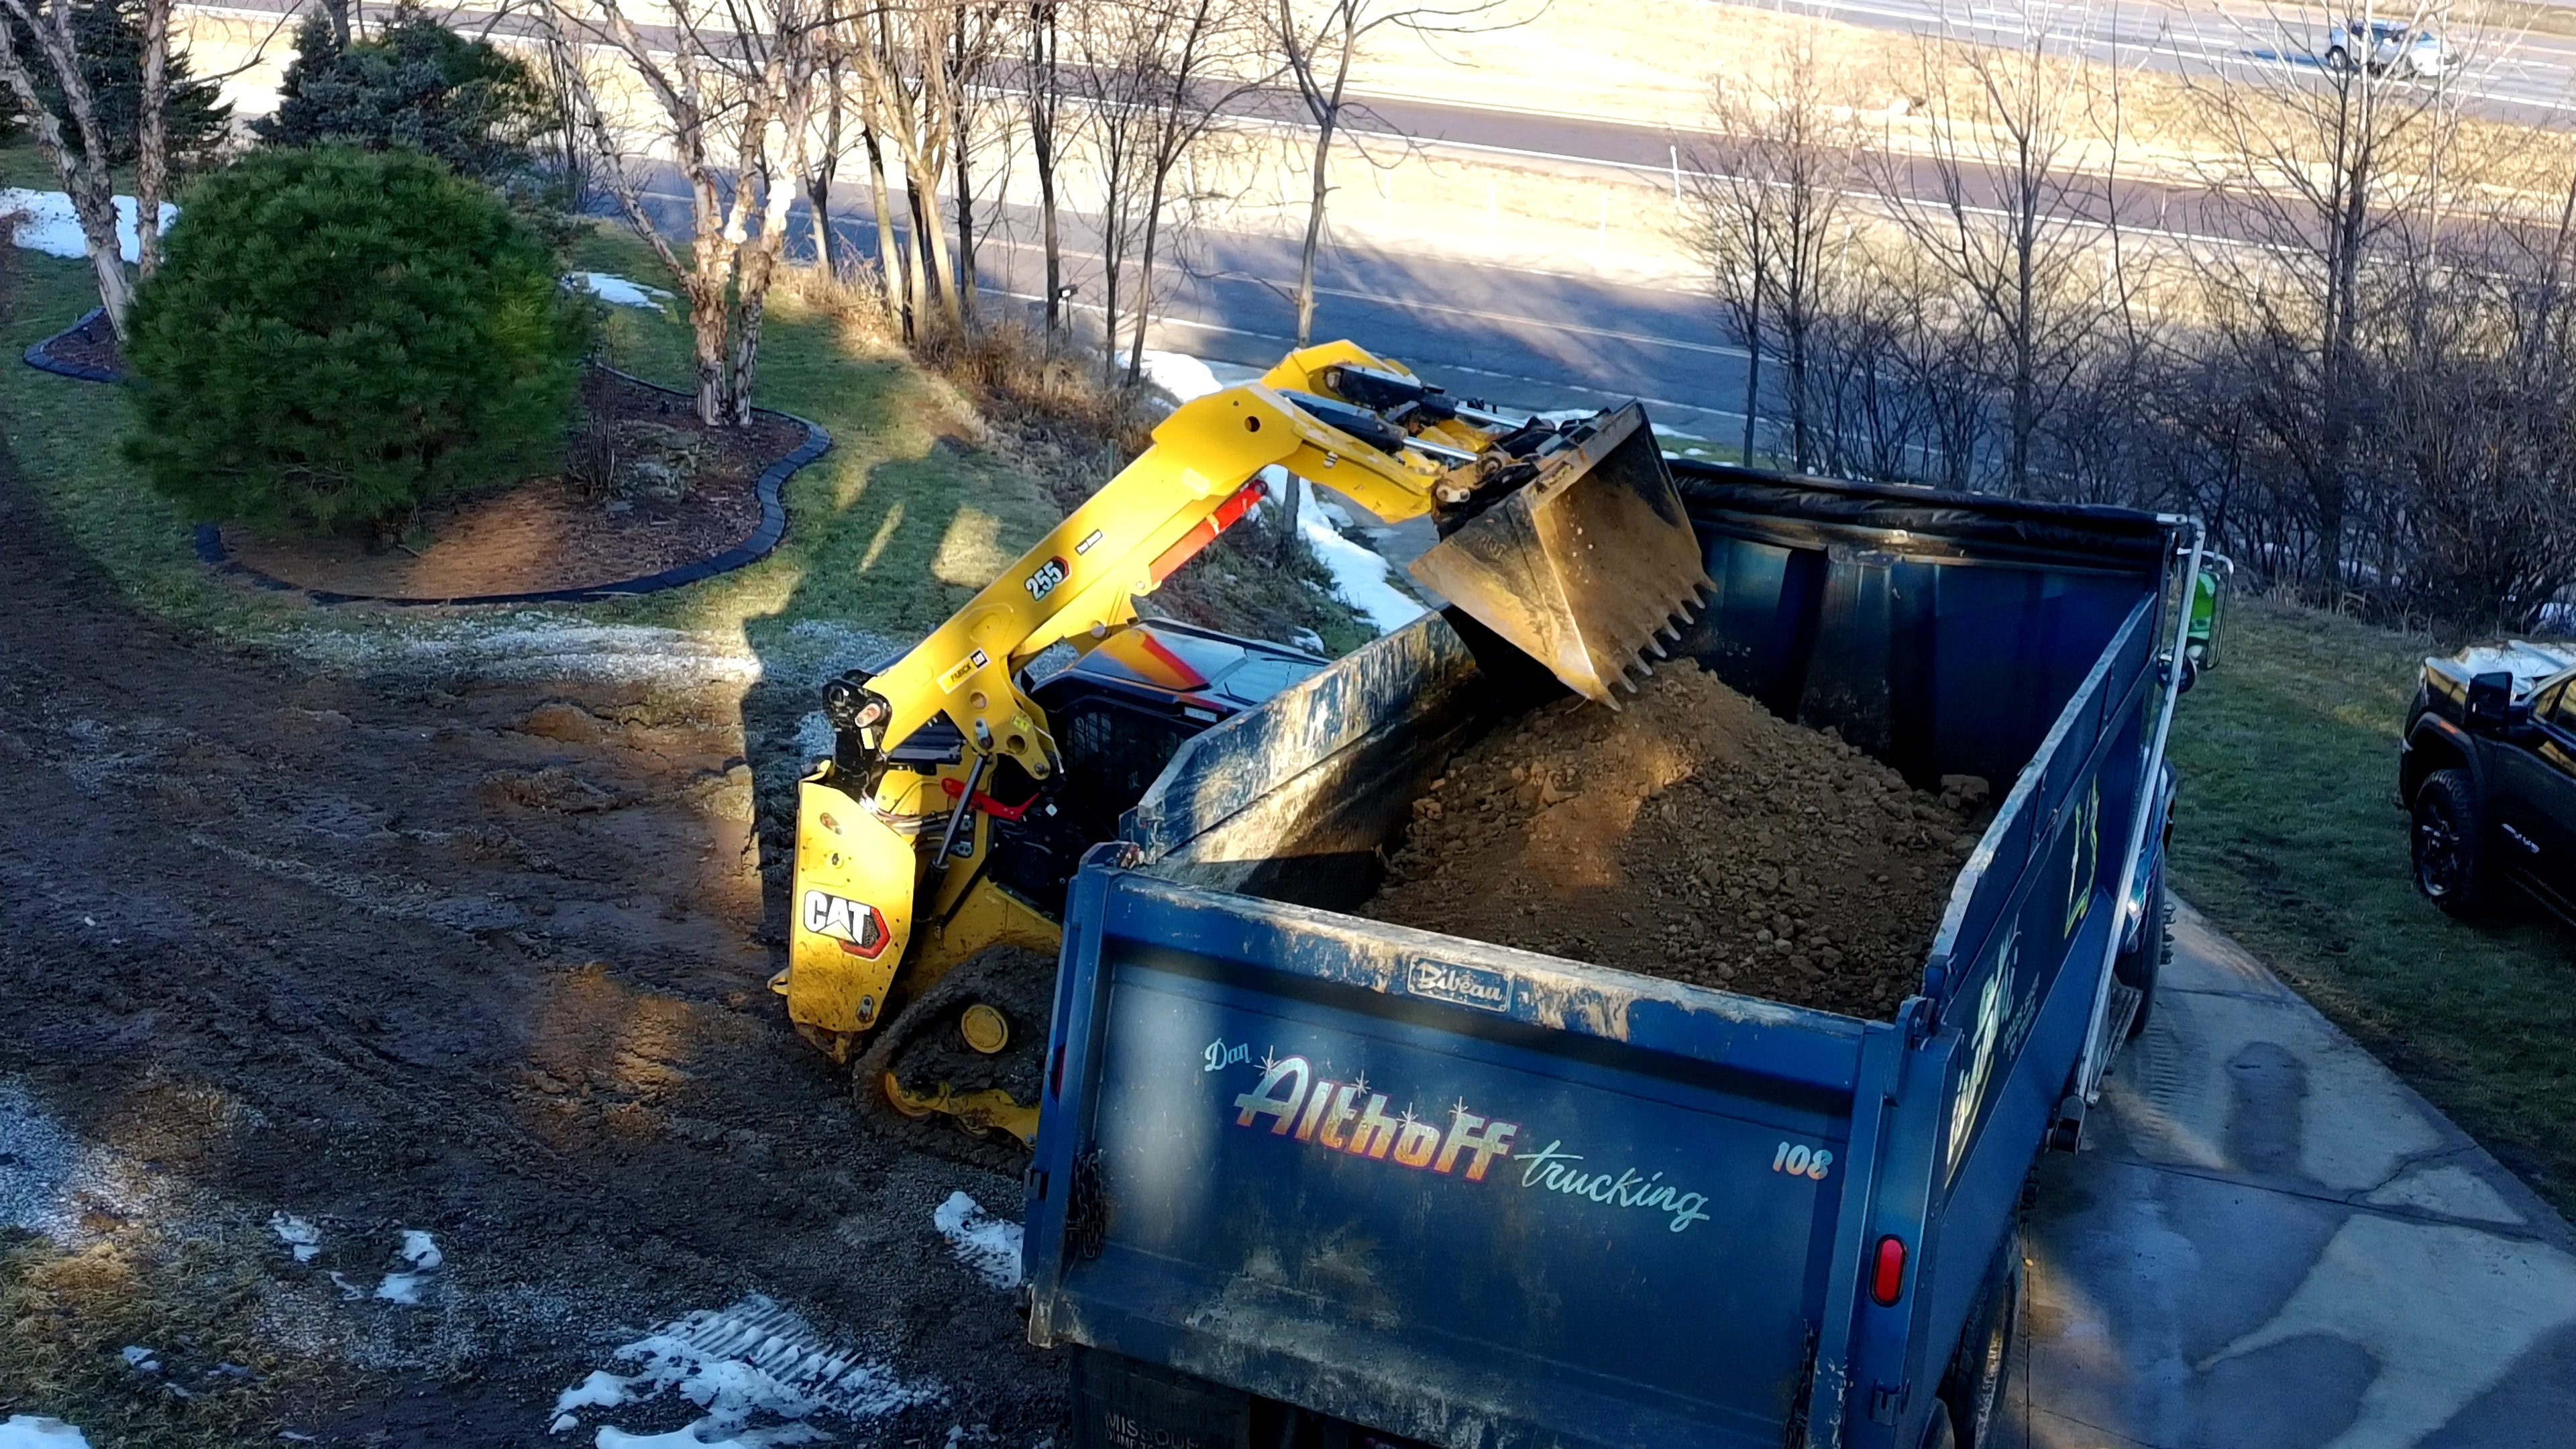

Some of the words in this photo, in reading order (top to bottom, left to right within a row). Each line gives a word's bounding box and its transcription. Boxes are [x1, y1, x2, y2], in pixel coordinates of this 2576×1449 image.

[1025, 561, 1063, 600] 255
[804, 890, 871, 945] CAT
[1204, 1037, 1252, 1072] Dan
[1233, 1053, 1520, 1182] Althoff
[1513, 1139, 1710, 1232] trucking
[1772, 1141, 1833, 1180] 108
